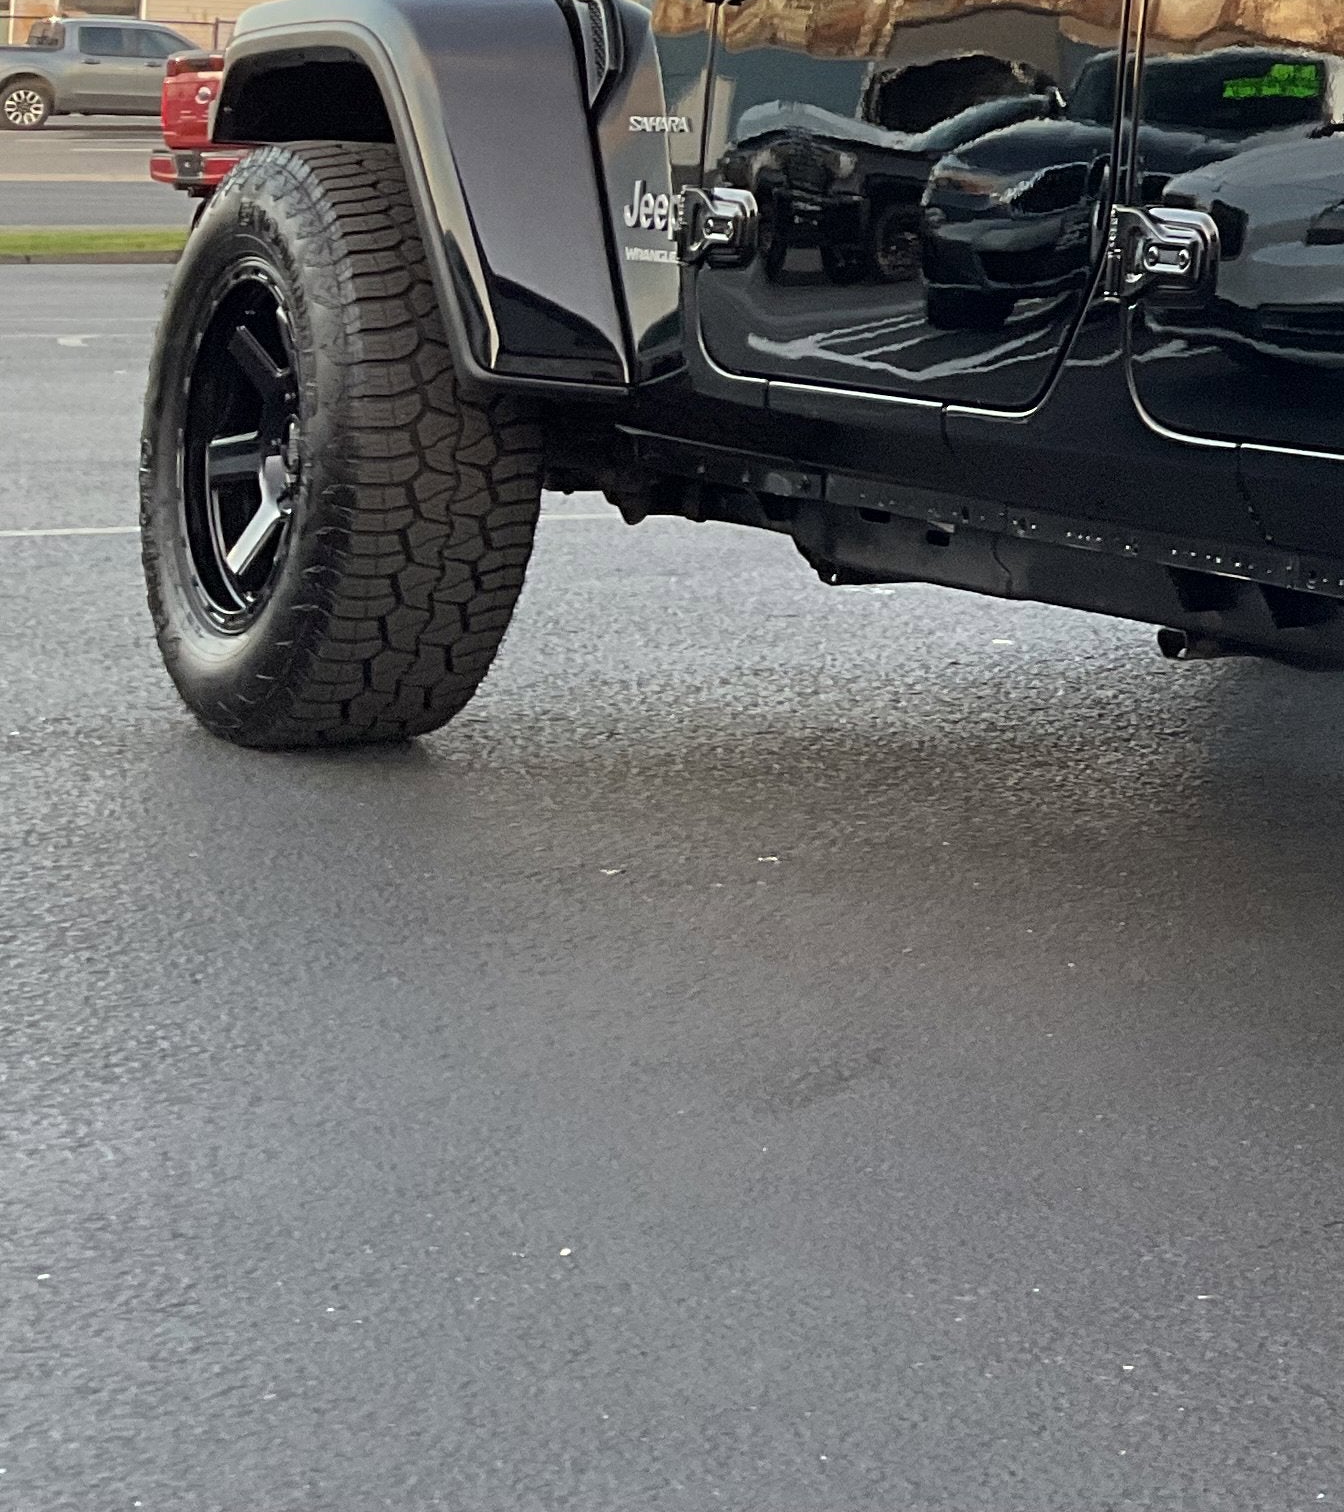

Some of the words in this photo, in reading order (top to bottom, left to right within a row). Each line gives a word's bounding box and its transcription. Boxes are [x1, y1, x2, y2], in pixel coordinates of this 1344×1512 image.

[628, 115, 690, 133] SAHARA
[623, 180, 683, 240] Jeep
[624, 246, 680, 263] WRANGLE
